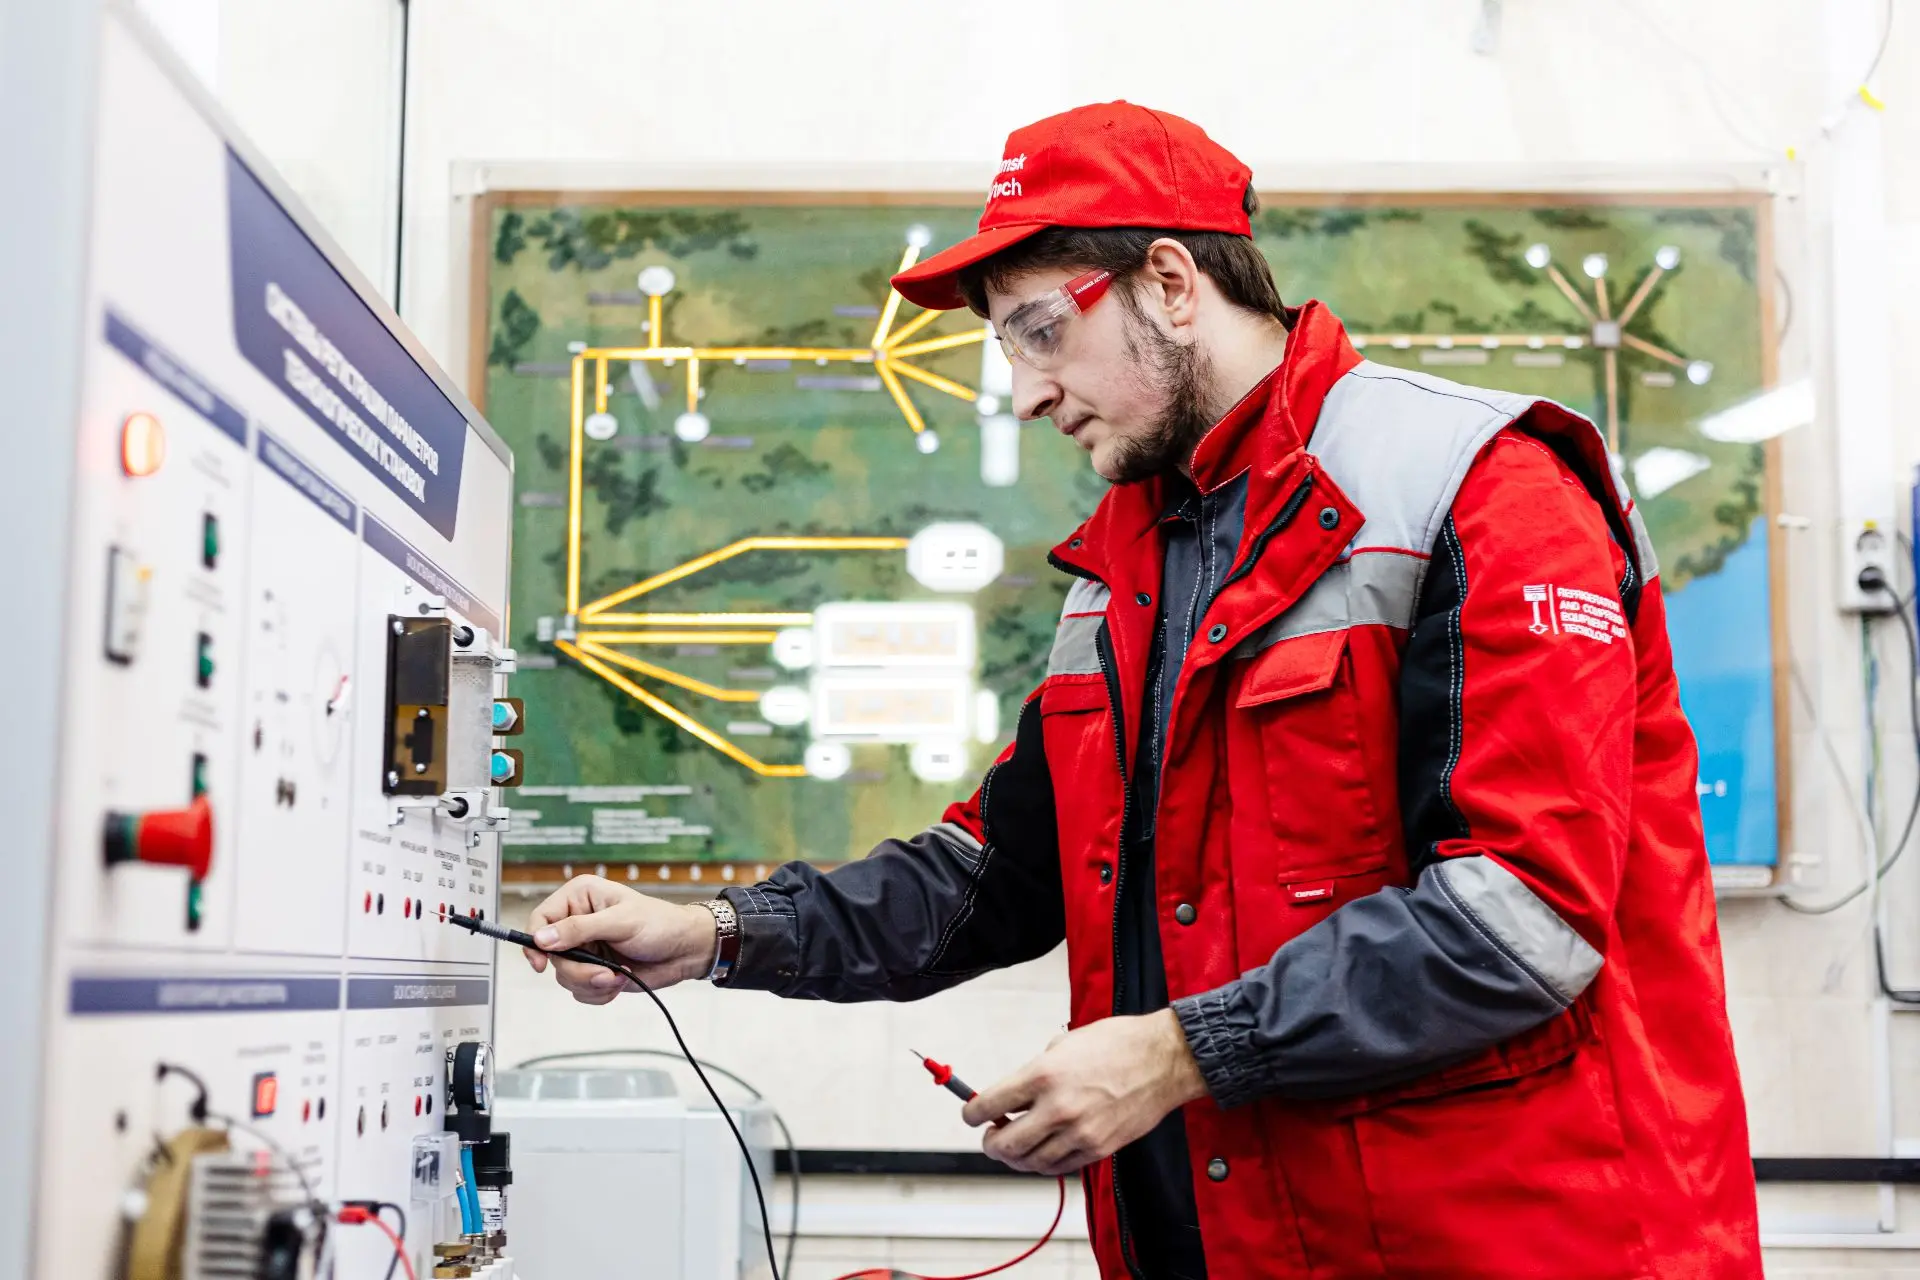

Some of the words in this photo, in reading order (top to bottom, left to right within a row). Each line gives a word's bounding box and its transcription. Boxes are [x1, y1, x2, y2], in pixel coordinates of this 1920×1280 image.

[1093, 271, 1110, 284] ACTIVE
[388, 404, 438, 475] ПАРАМЕТРОВ
[380, 440, 425, 503] УСТАНОВОК
[1557, 588, 1620, 612] REFRIGERATION
[1560, 600, 1580, 610] AND
[1560, 611, 1609, 630] EQUIPMENT
[1611, 625, 1626, 638] AND
